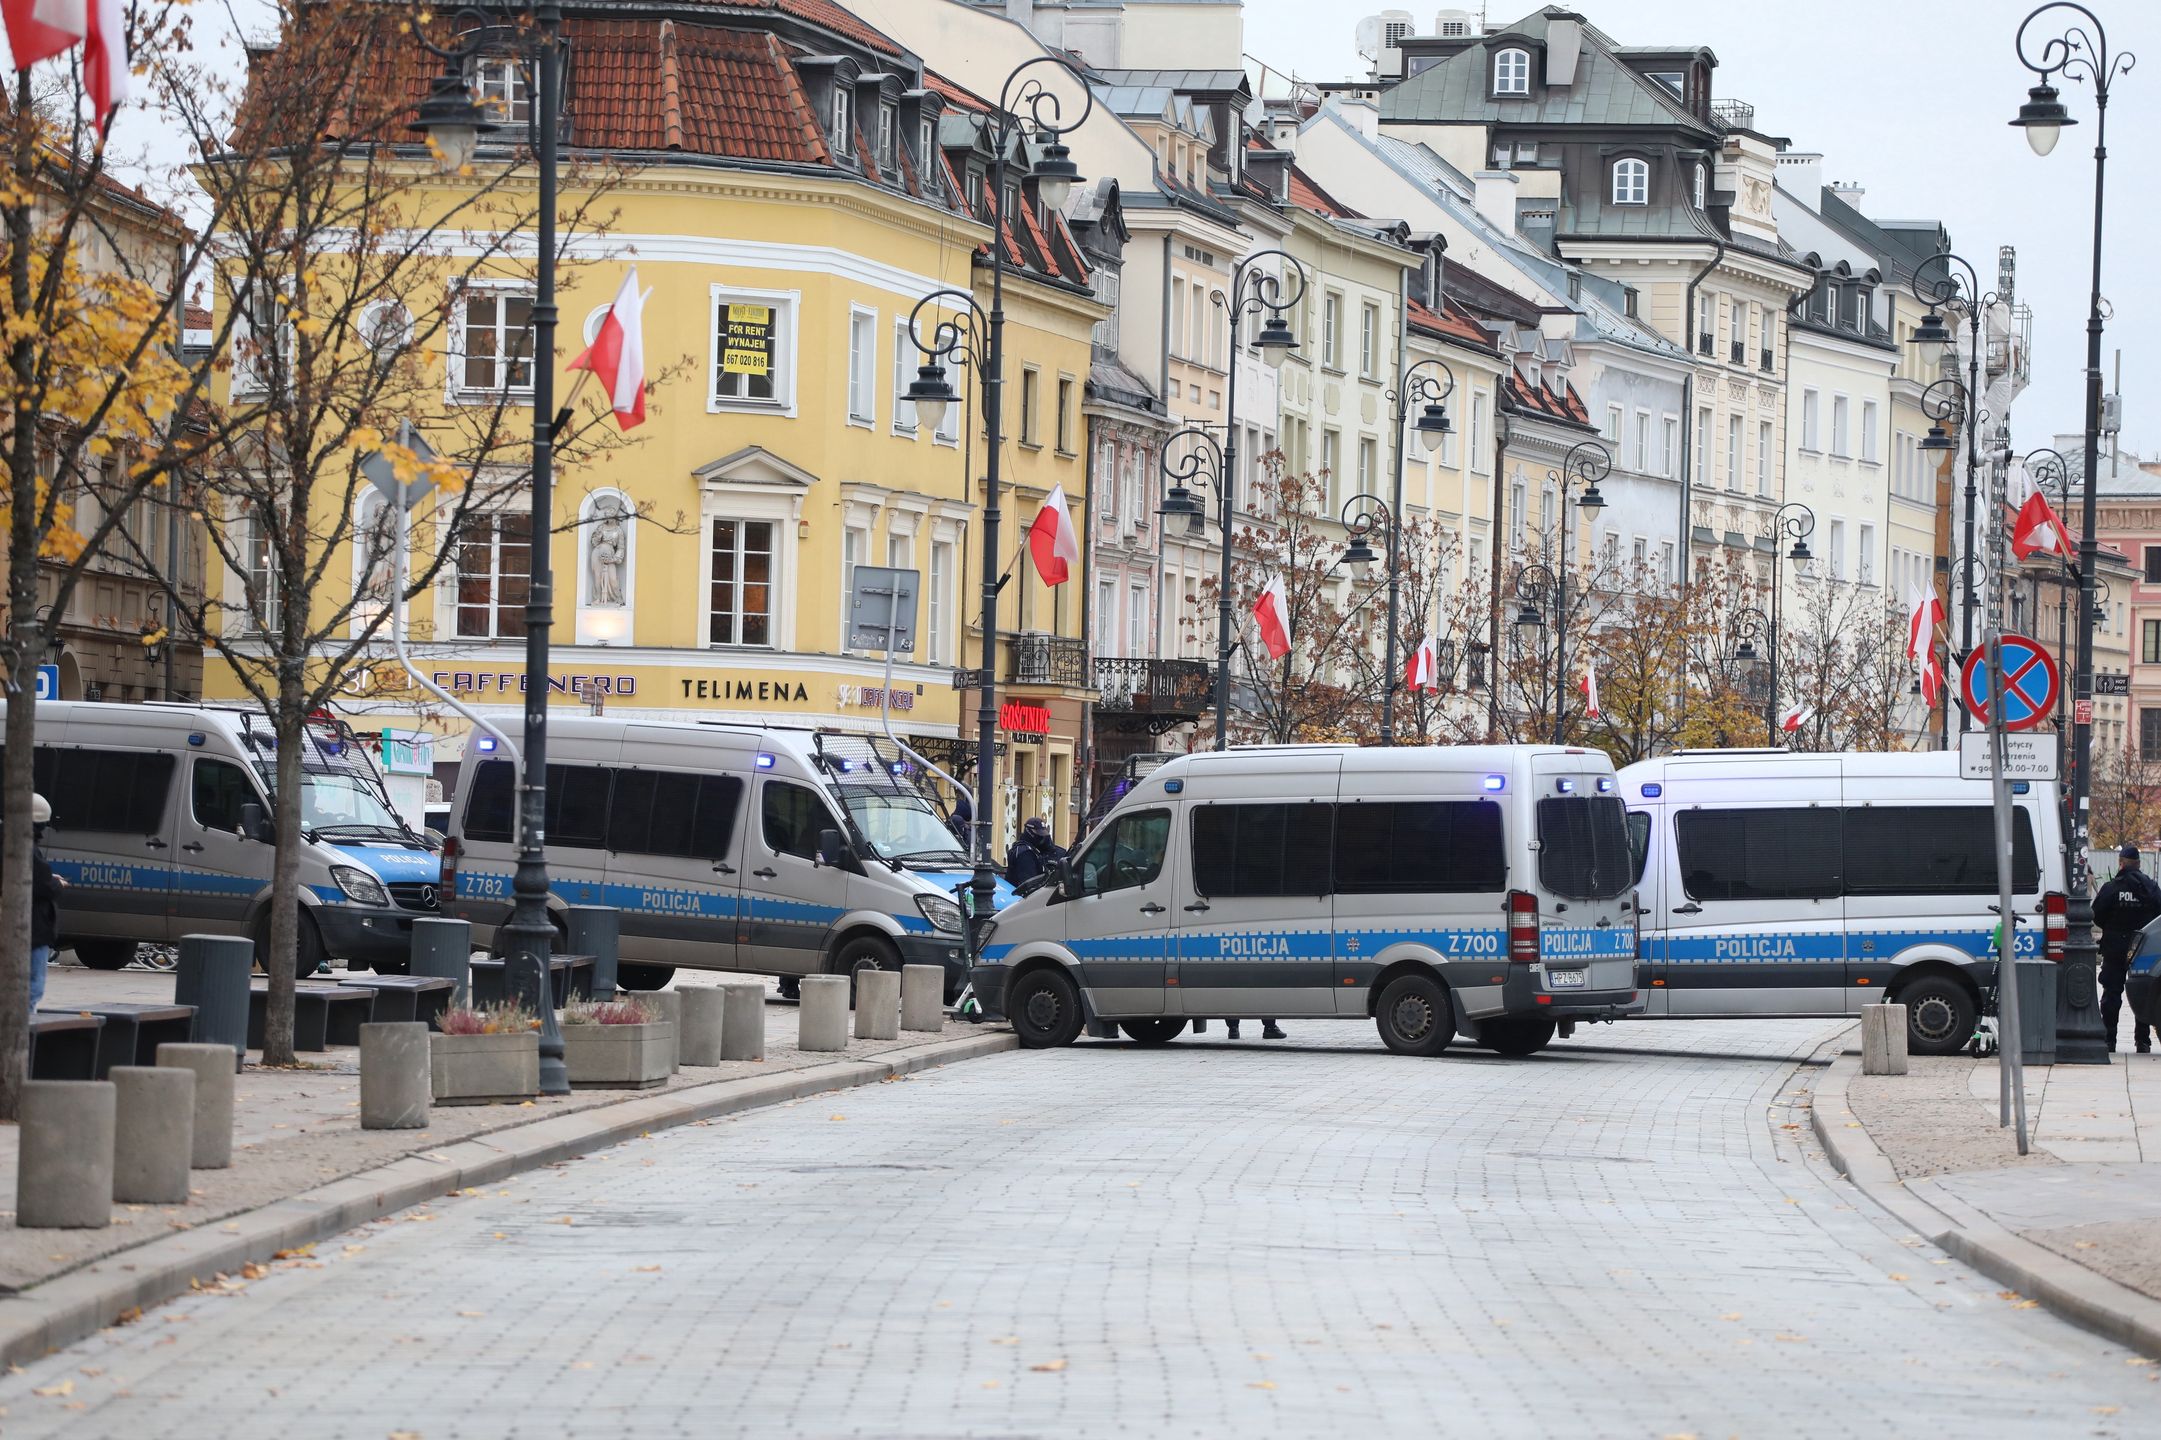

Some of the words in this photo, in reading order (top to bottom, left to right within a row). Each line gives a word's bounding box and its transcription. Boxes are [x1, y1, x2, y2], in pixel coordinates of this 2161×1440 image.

[728, 324, 743, 334] FOR
[745, 326, 766, 336] RENT
[728, 337, 766, 349] WYNAJEM
[727, 354, 738, 365] 667
[740, 355, 752, 366] 020
[753, 357, 765, 367] 816
[682, 679, 809, 702] TELIMENA
[861, 687, 885, 708] CAFF
[1000, 699, 1052, 733] GOŚCINIEC
[2007, 741, 2033, 750] otyczy
[81, 866, 132, 885] POLICJA
[643, 891, 701, 912] POLICJA
[1220, 937, 1289, 955] POLICJA
[1544, 933, 1593, 953] POLICJA
[1715, 939, 1796, 957] POLICJA
